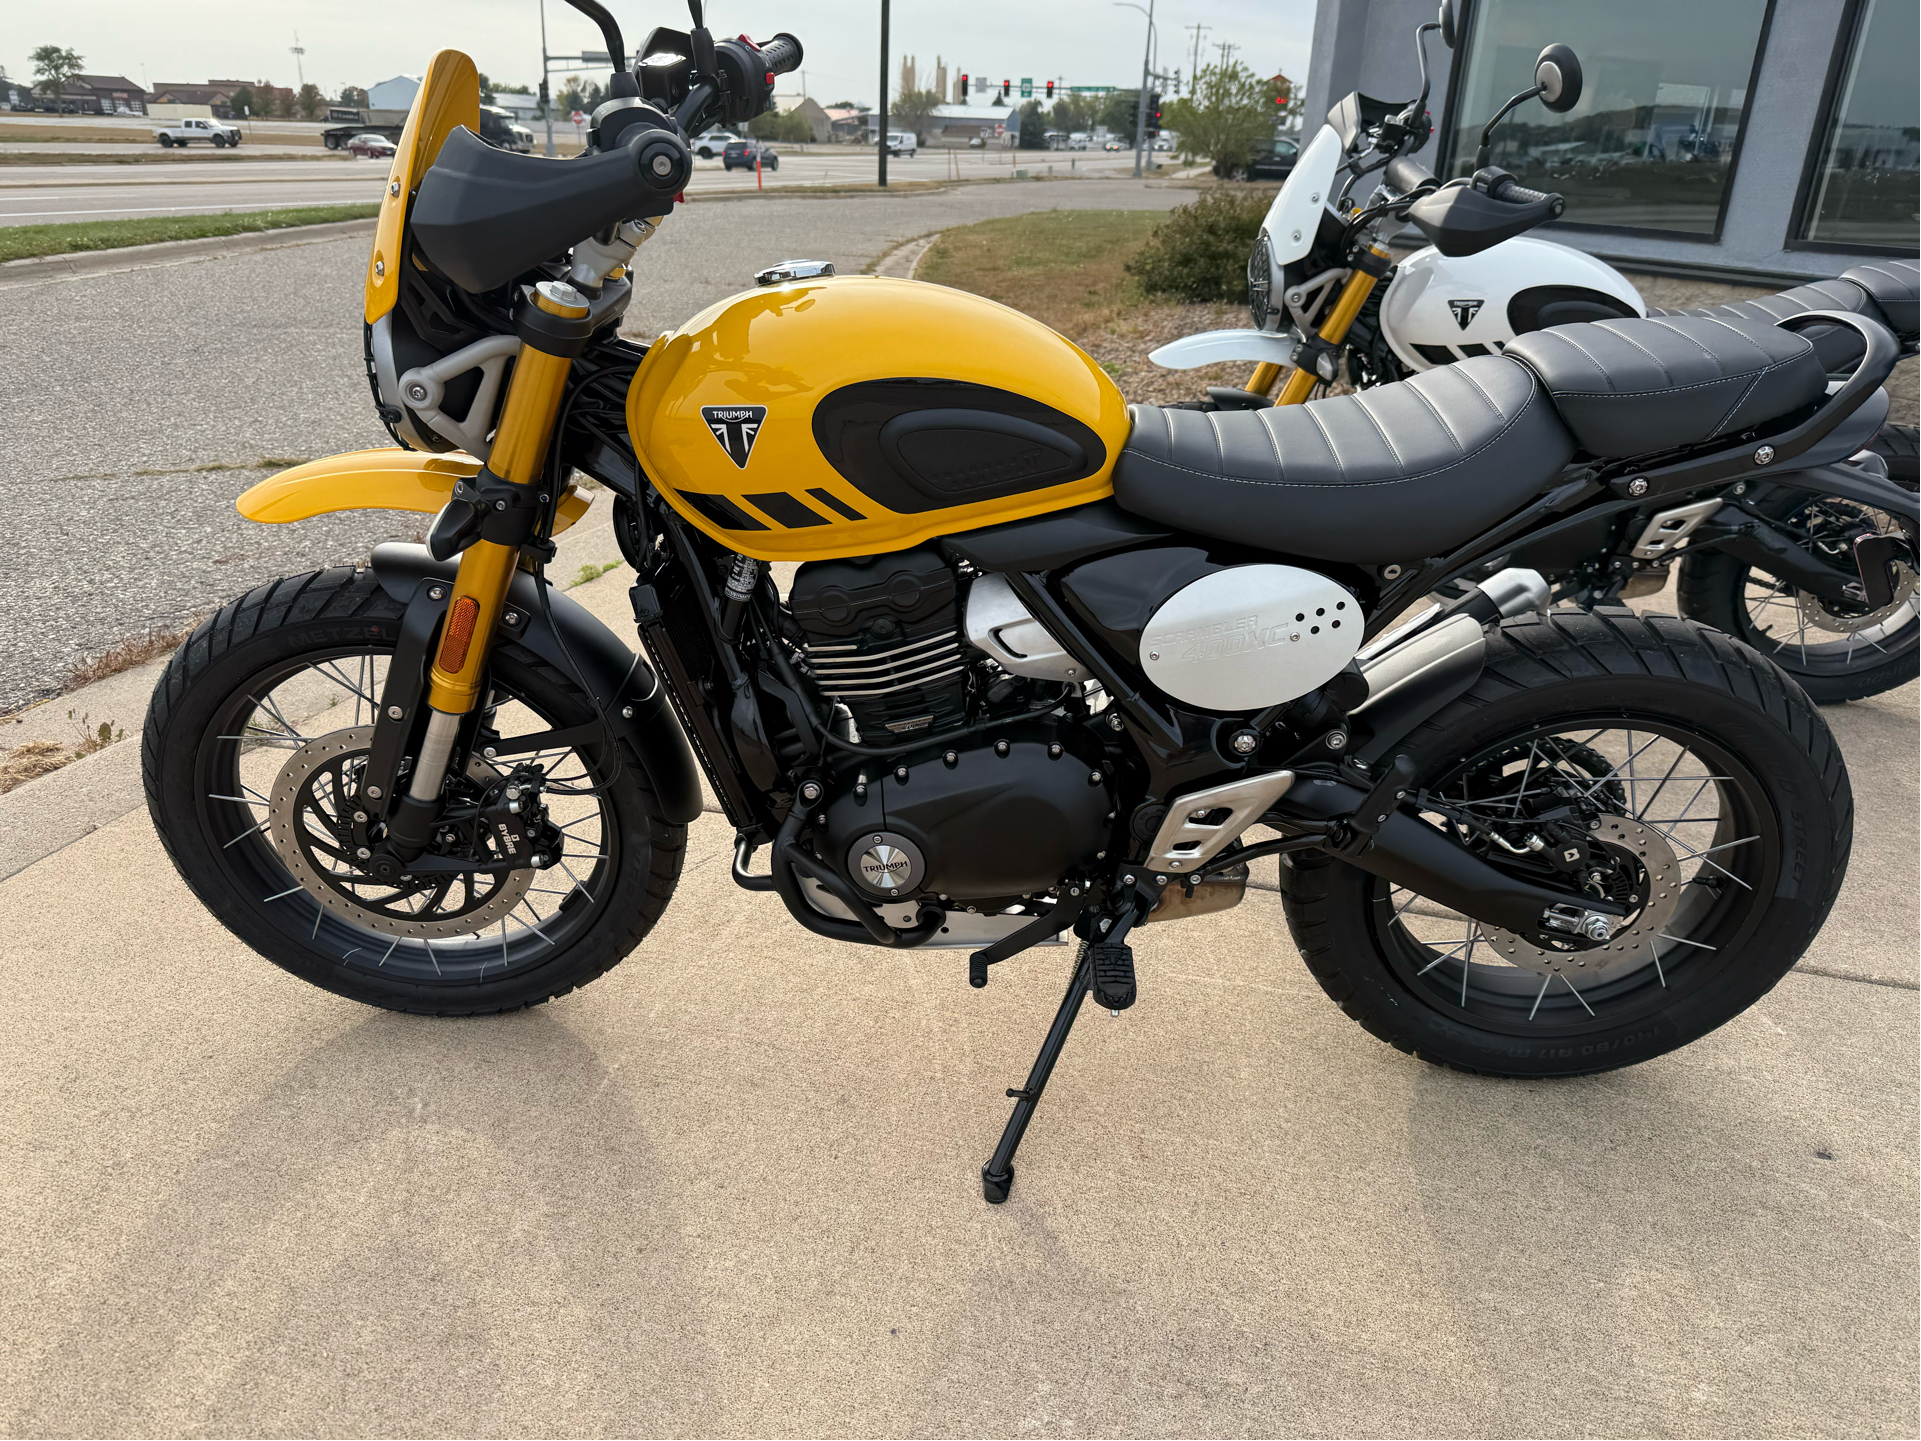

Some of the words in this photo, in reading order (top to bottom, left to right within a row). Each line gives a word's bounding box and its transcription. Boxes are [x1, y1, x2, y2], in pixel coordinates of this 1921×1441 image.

[712, 410, 753, 420] TRIUMPH
[1149, 615, 1258, 648] SCRAMBLER
[498, 823, 517, 855] BYBRE
[1790, 808, 1808, 886] STREET
[863, 861, 908, 873] TRIUMPH
